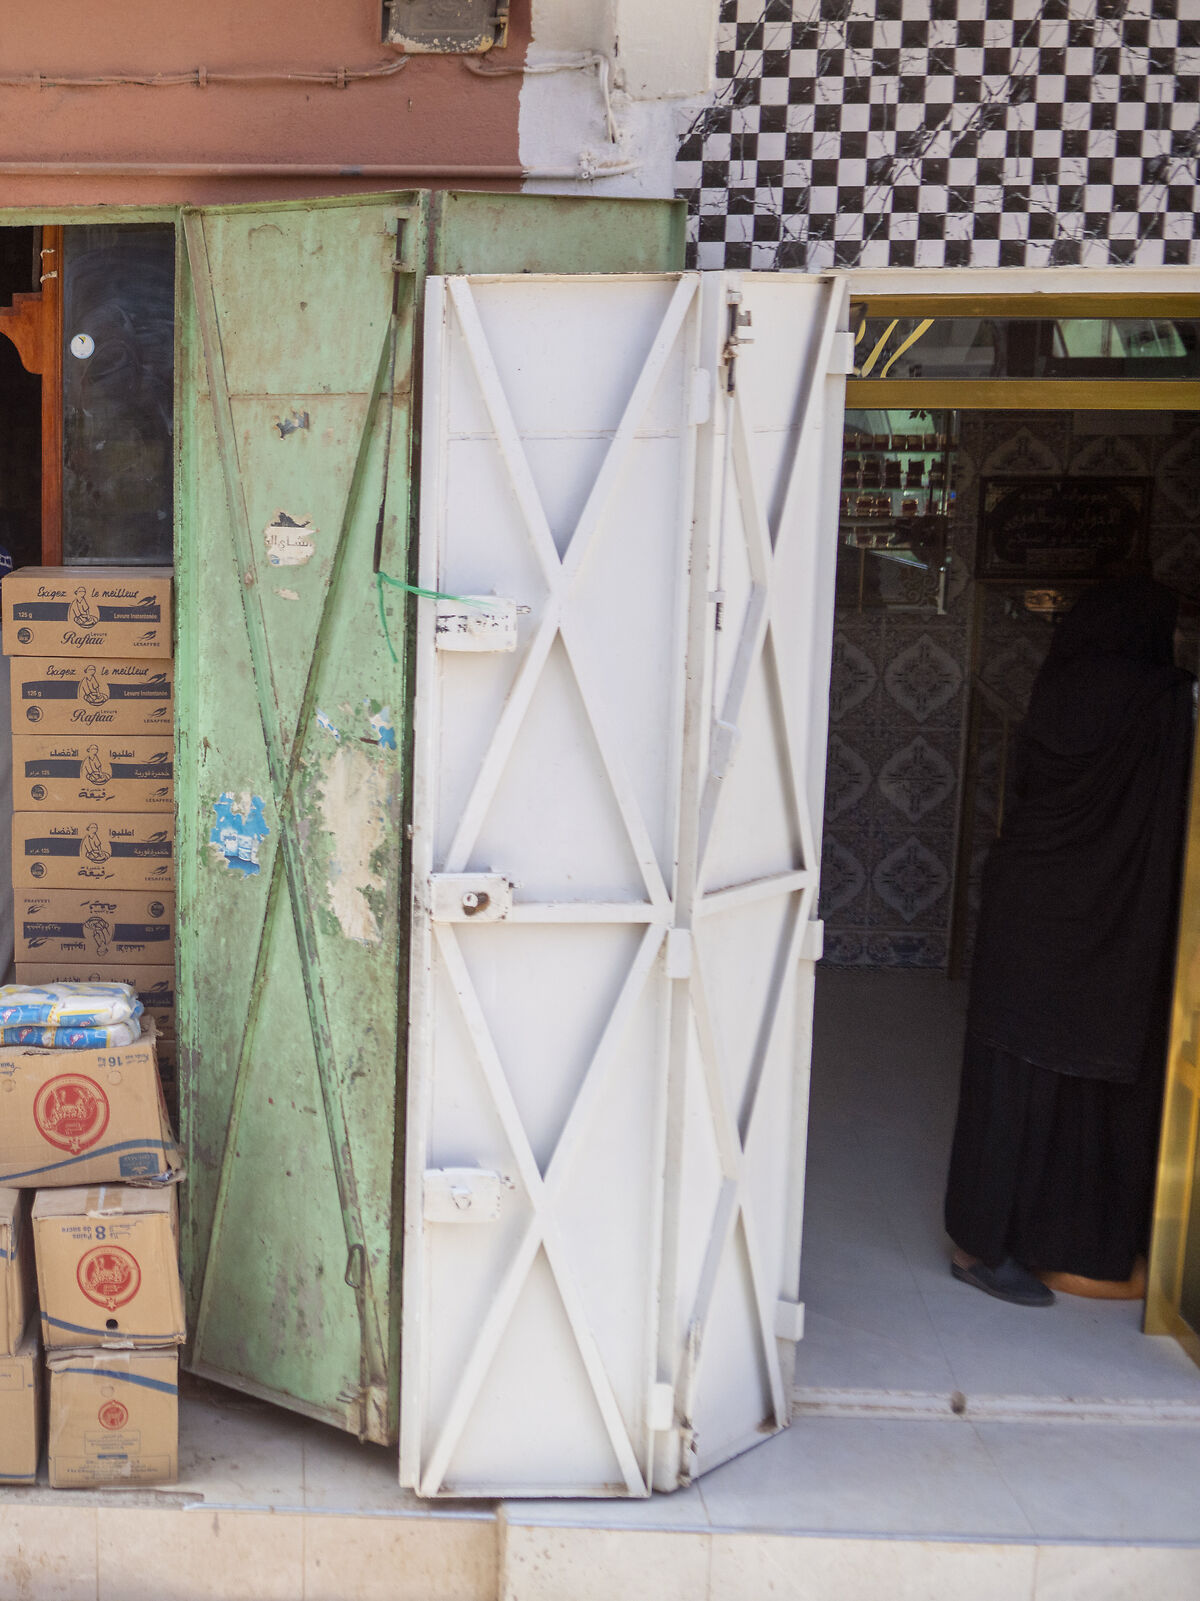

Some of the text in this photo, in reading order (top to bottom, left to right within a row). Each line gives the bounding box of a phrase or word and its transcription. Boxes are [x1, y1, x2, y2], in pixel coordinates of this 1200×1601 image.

[37, 586, 140, 600] Exigez le meilleur
[46, 664, 150, 679] Exigez le meilleur
[109, 749, 135, 759] اطلبوا
[108, 828, 135, 838] اطلبوا
[108, 1056, 123, 1066] 16
[95, 1225, 106, 1240] 8
